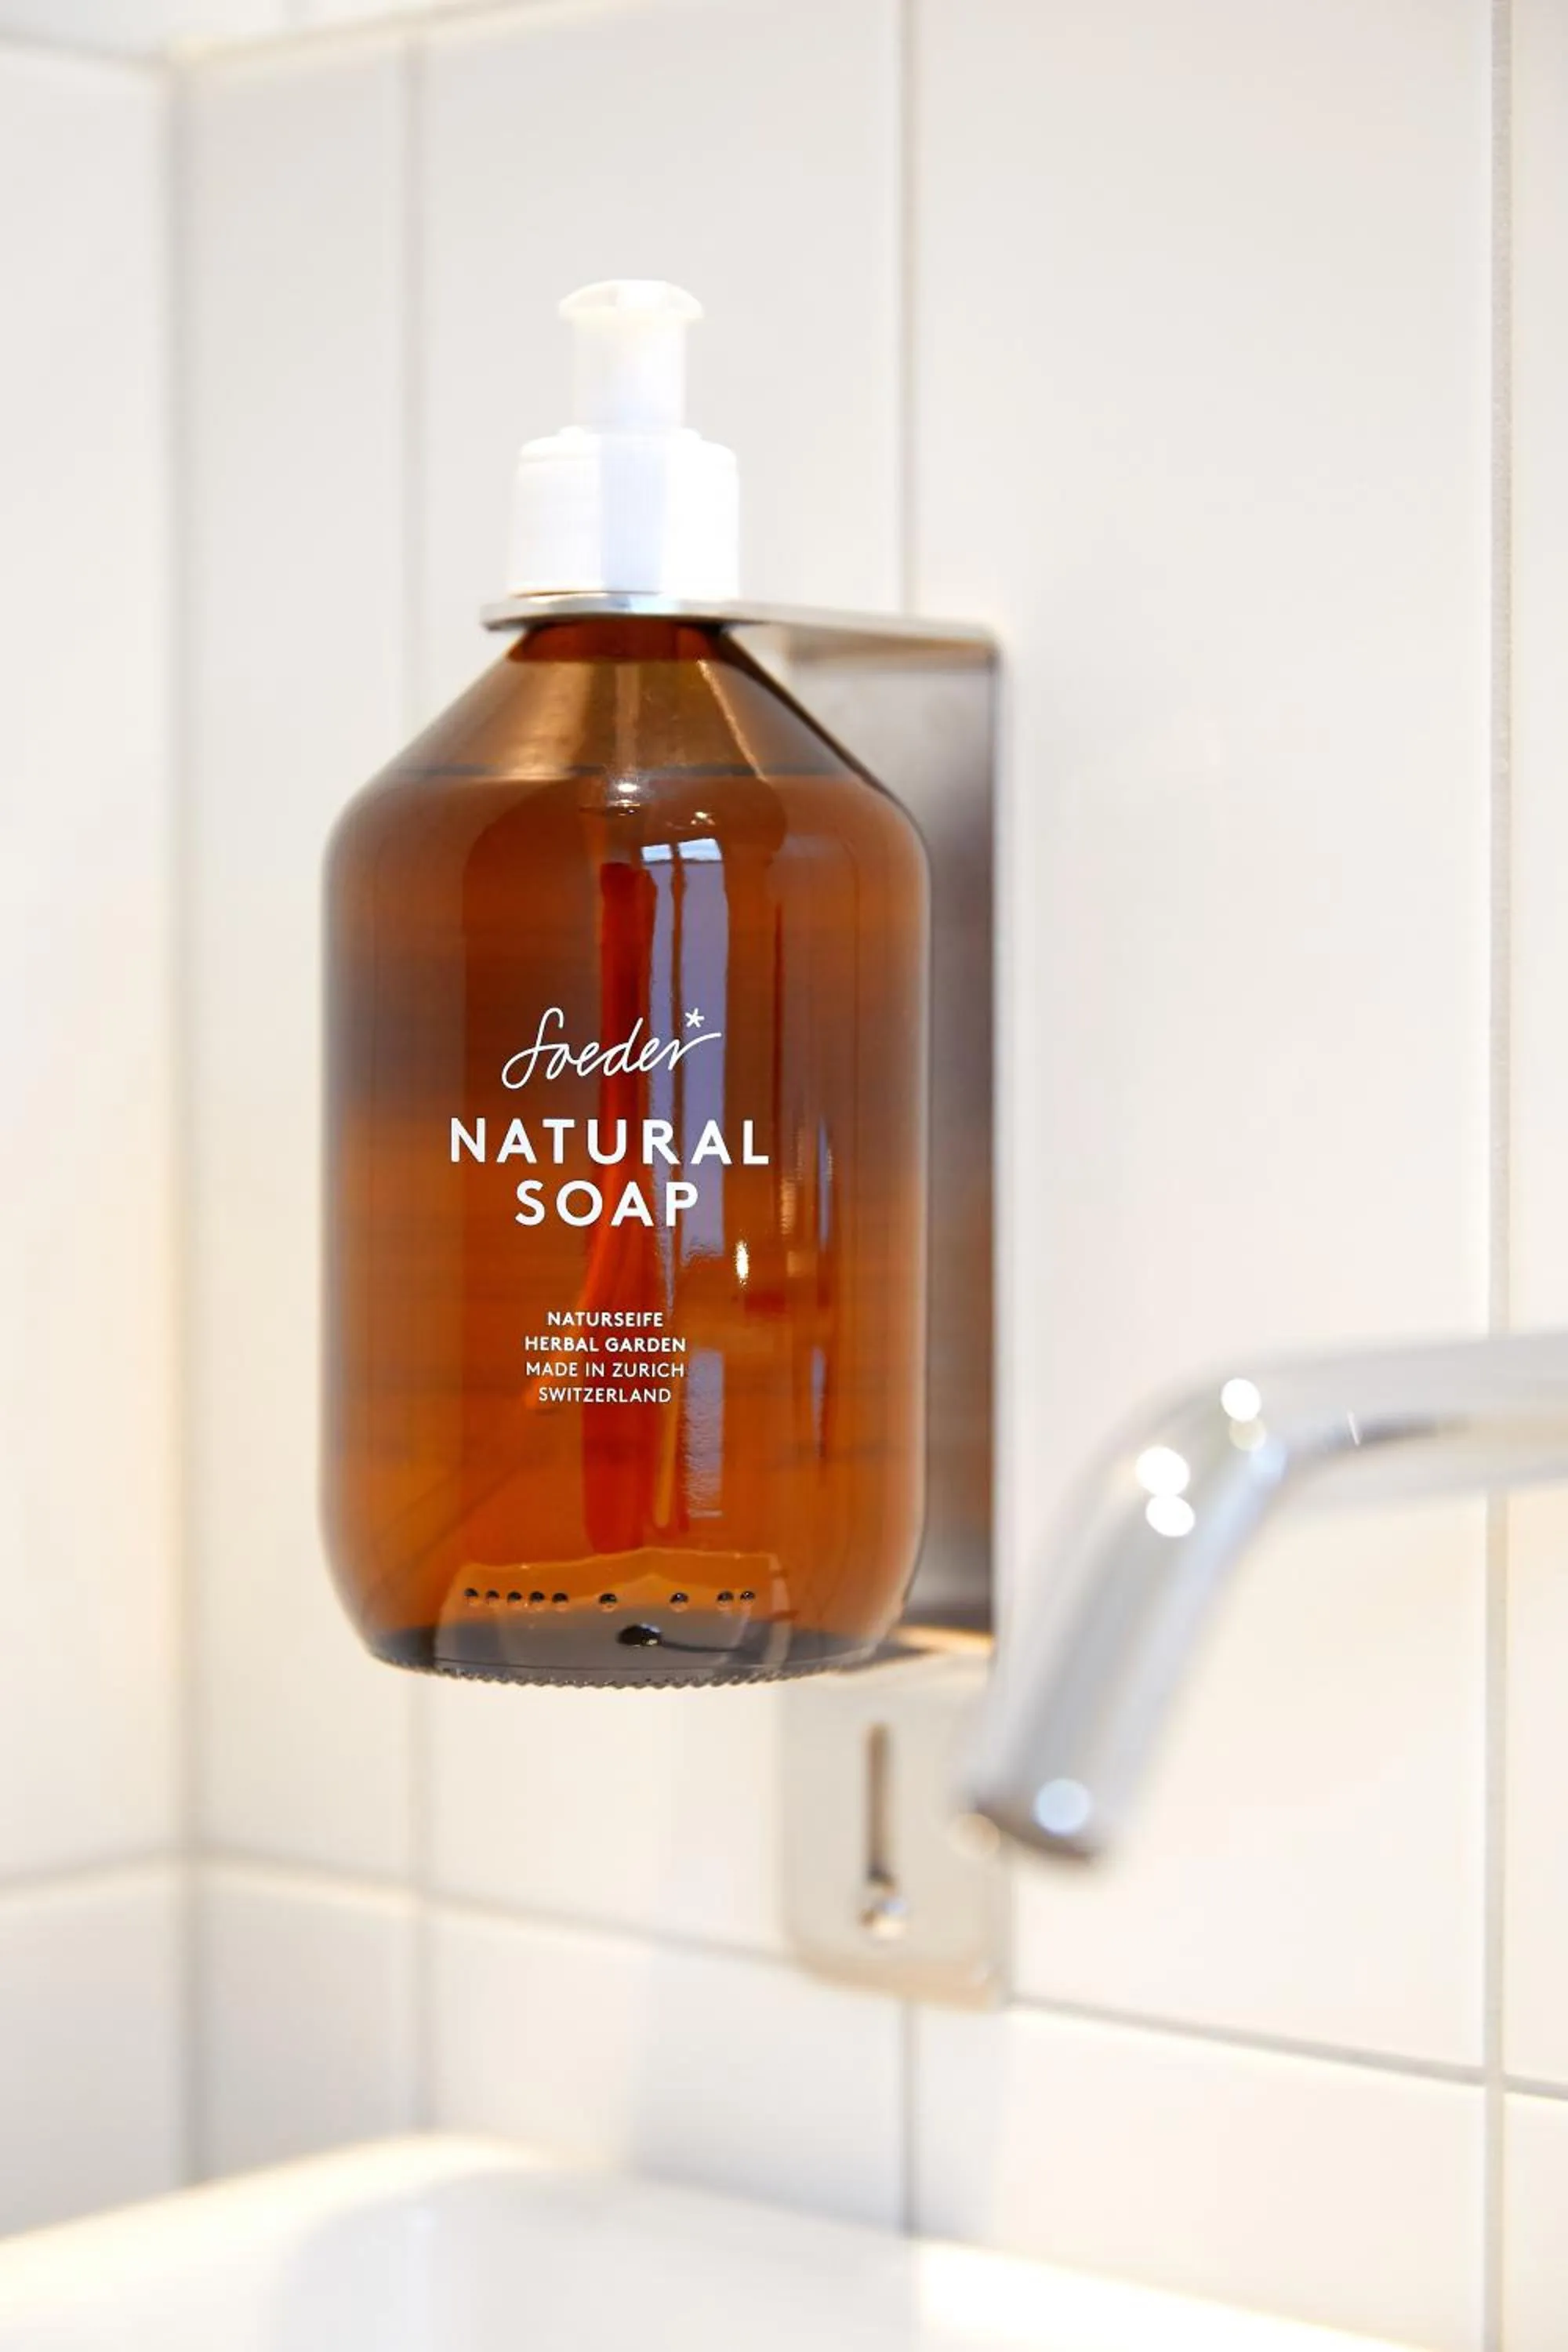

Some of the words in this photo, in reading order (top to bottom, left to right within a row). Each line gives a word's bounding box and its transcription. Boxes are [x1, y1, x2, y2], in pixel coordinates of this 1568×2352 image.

[451, 1118, 769, 1165] NATURAL
[516, 1180, 699, 1226] SOAP
[547, 1312, 663, 1327] NATURSEIFE
[525, 1336, 599, 1352] HERBAL
[604, 1337, 685, 1352] GARDEN
[526, 1362, 578, 1377] MADE
[586, 1363, 604, 1377] IN
[612, 1363, 684, 1377] ZURICH
[539, 1387, 671, 1403] SWITZERLAND
